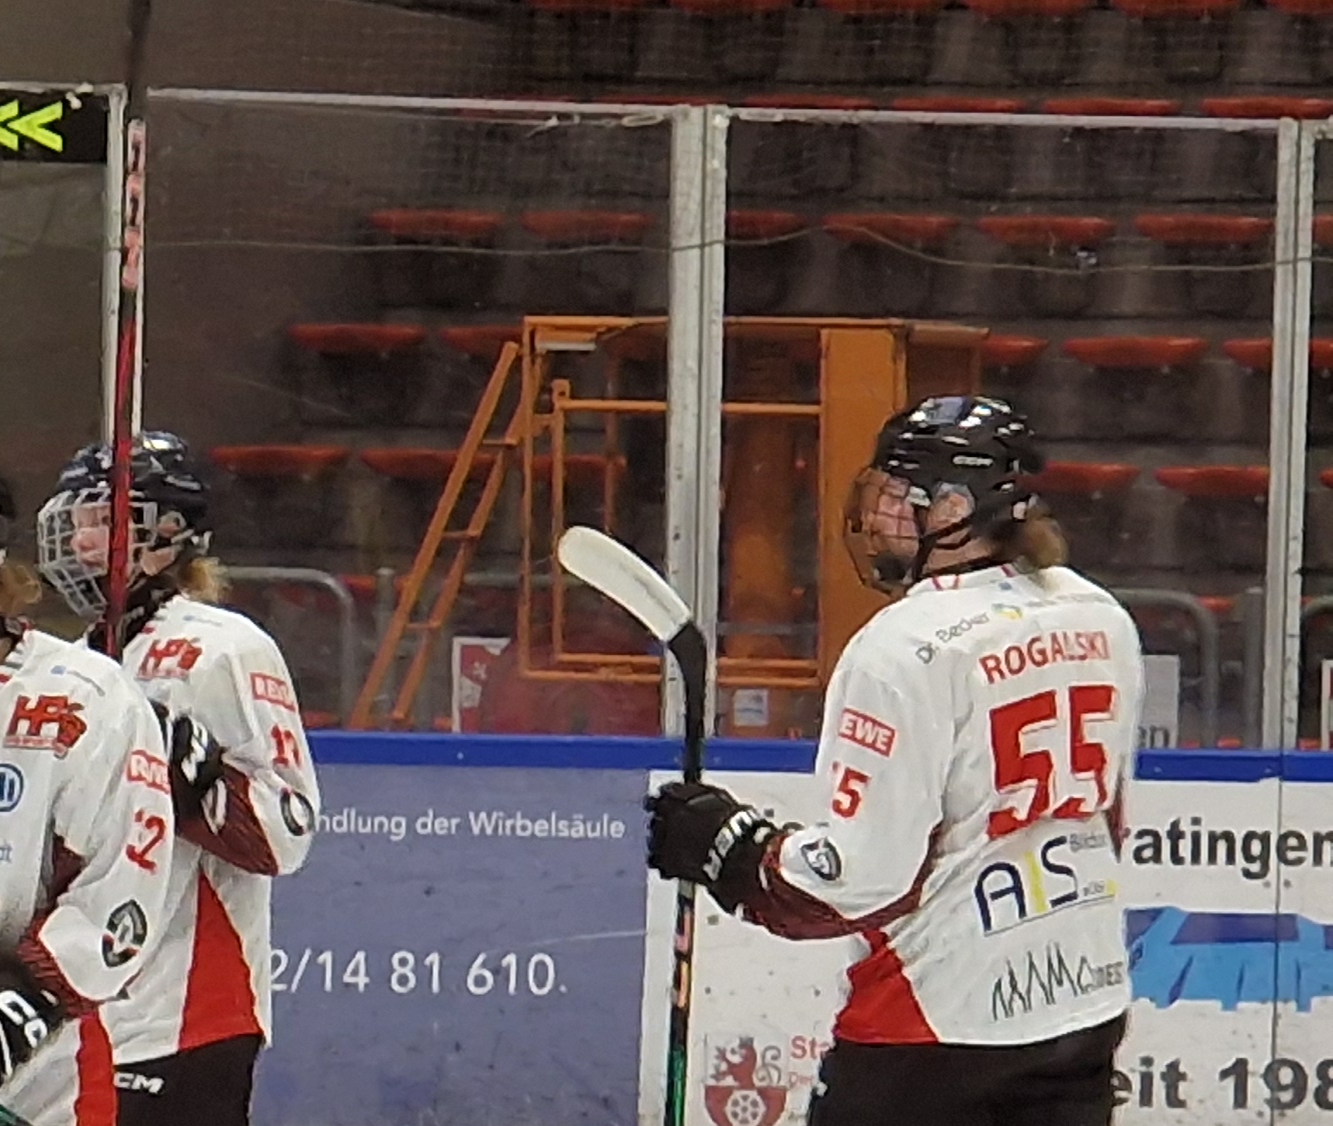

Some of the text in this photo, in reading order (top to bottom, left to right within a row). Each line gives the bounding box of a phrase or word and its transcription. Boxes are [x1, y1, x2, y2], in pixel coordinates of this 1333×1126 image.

[979, 631, 1111, 684] ROGALSKI
[987, 685, 1116, 840] 55
[414, 809, 461, 836] der
[468, 810, 626, 839] Wirbelsäule
[975, 835, 1079, 931] AIS
[390, 950, 442, 994] 81
[466, 951, 568, 995] 610.
